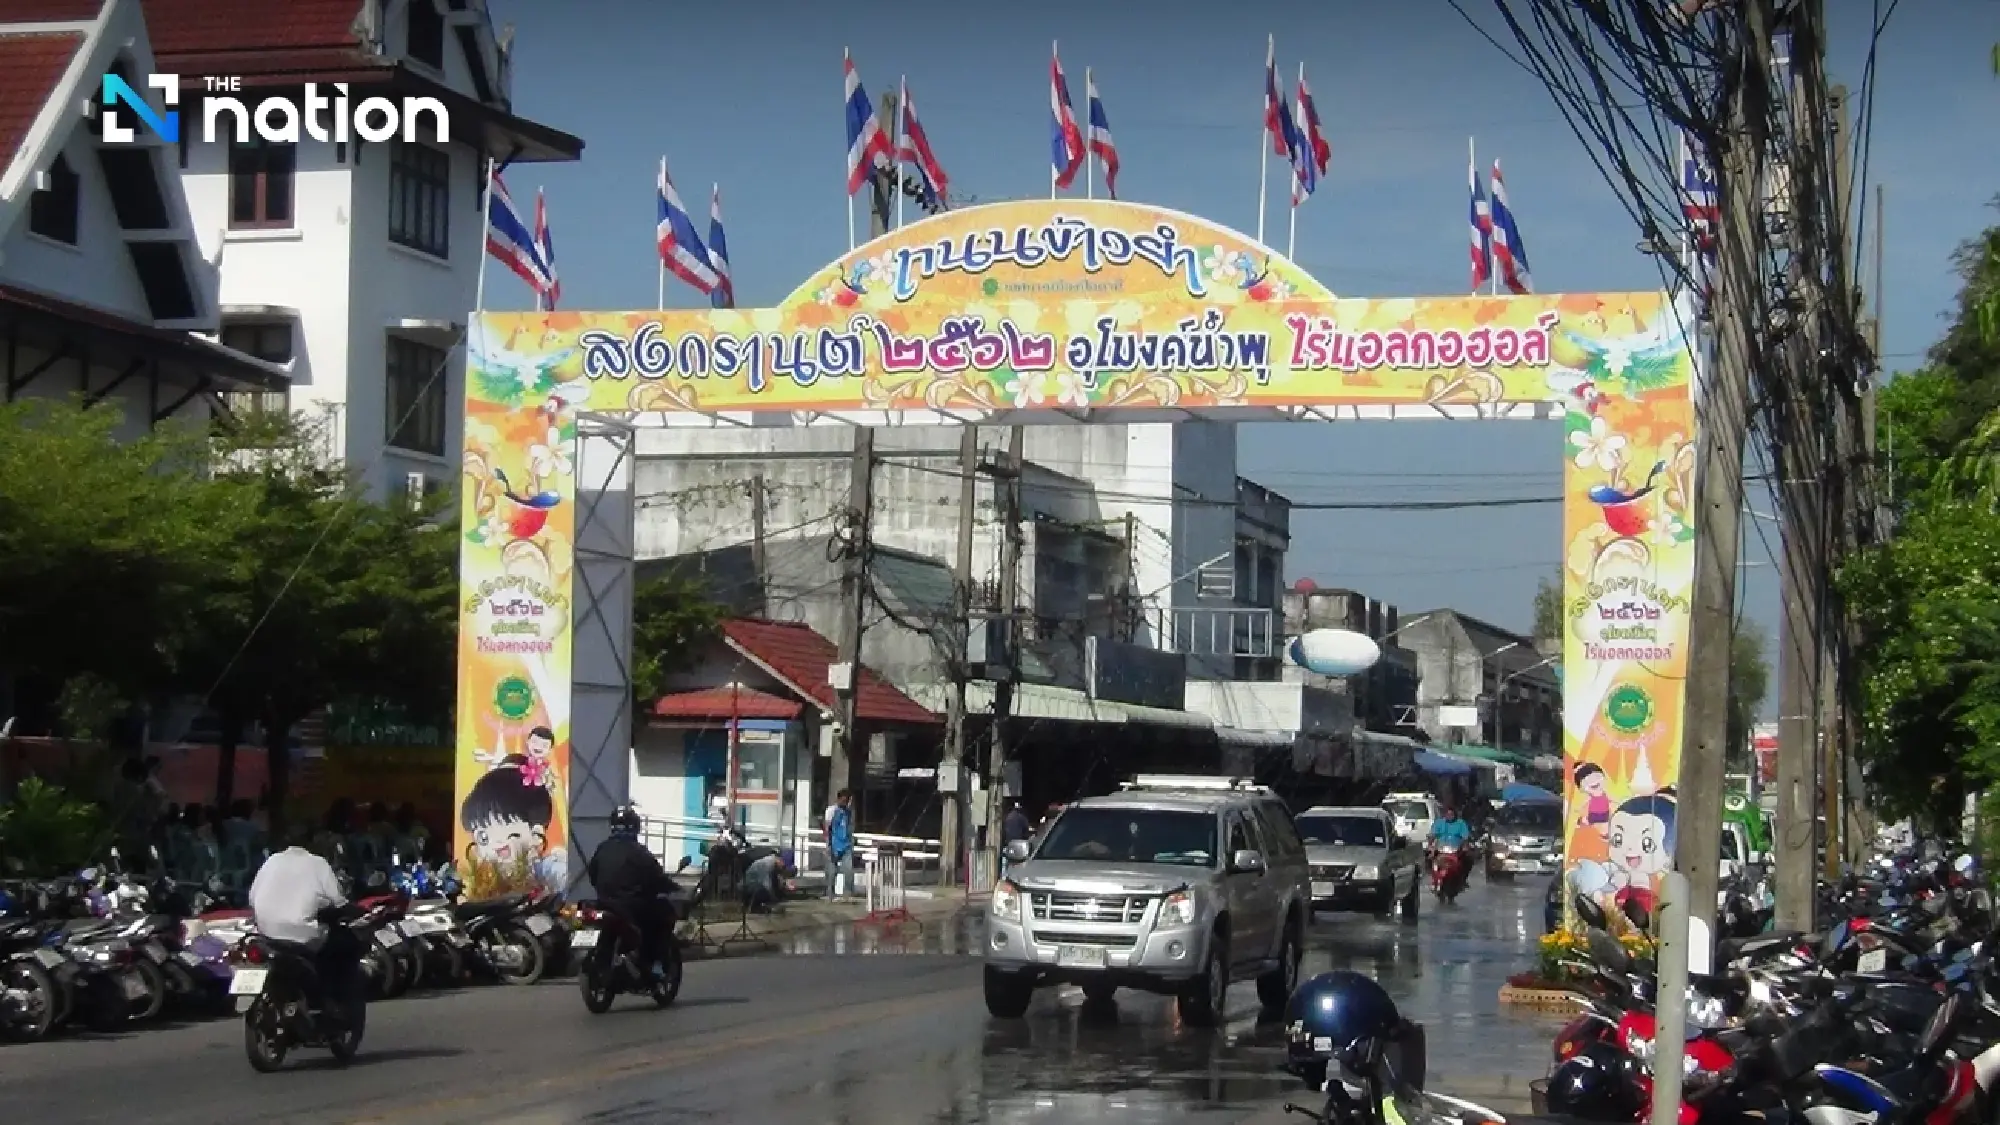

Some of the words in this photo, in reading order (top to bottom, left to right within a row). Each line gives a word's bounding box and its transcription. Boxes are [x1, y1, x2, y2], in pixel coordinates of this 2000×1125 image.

[580, 314, 871, 393] สงกรานต์
[875, 316, 1057, 373] ๒๕๖๒
[1067, 309, 1271, 386] อุโมงค์น้ำพุ
[1286, 311, 1559, 371] ไร้แอลกอฮอล์
